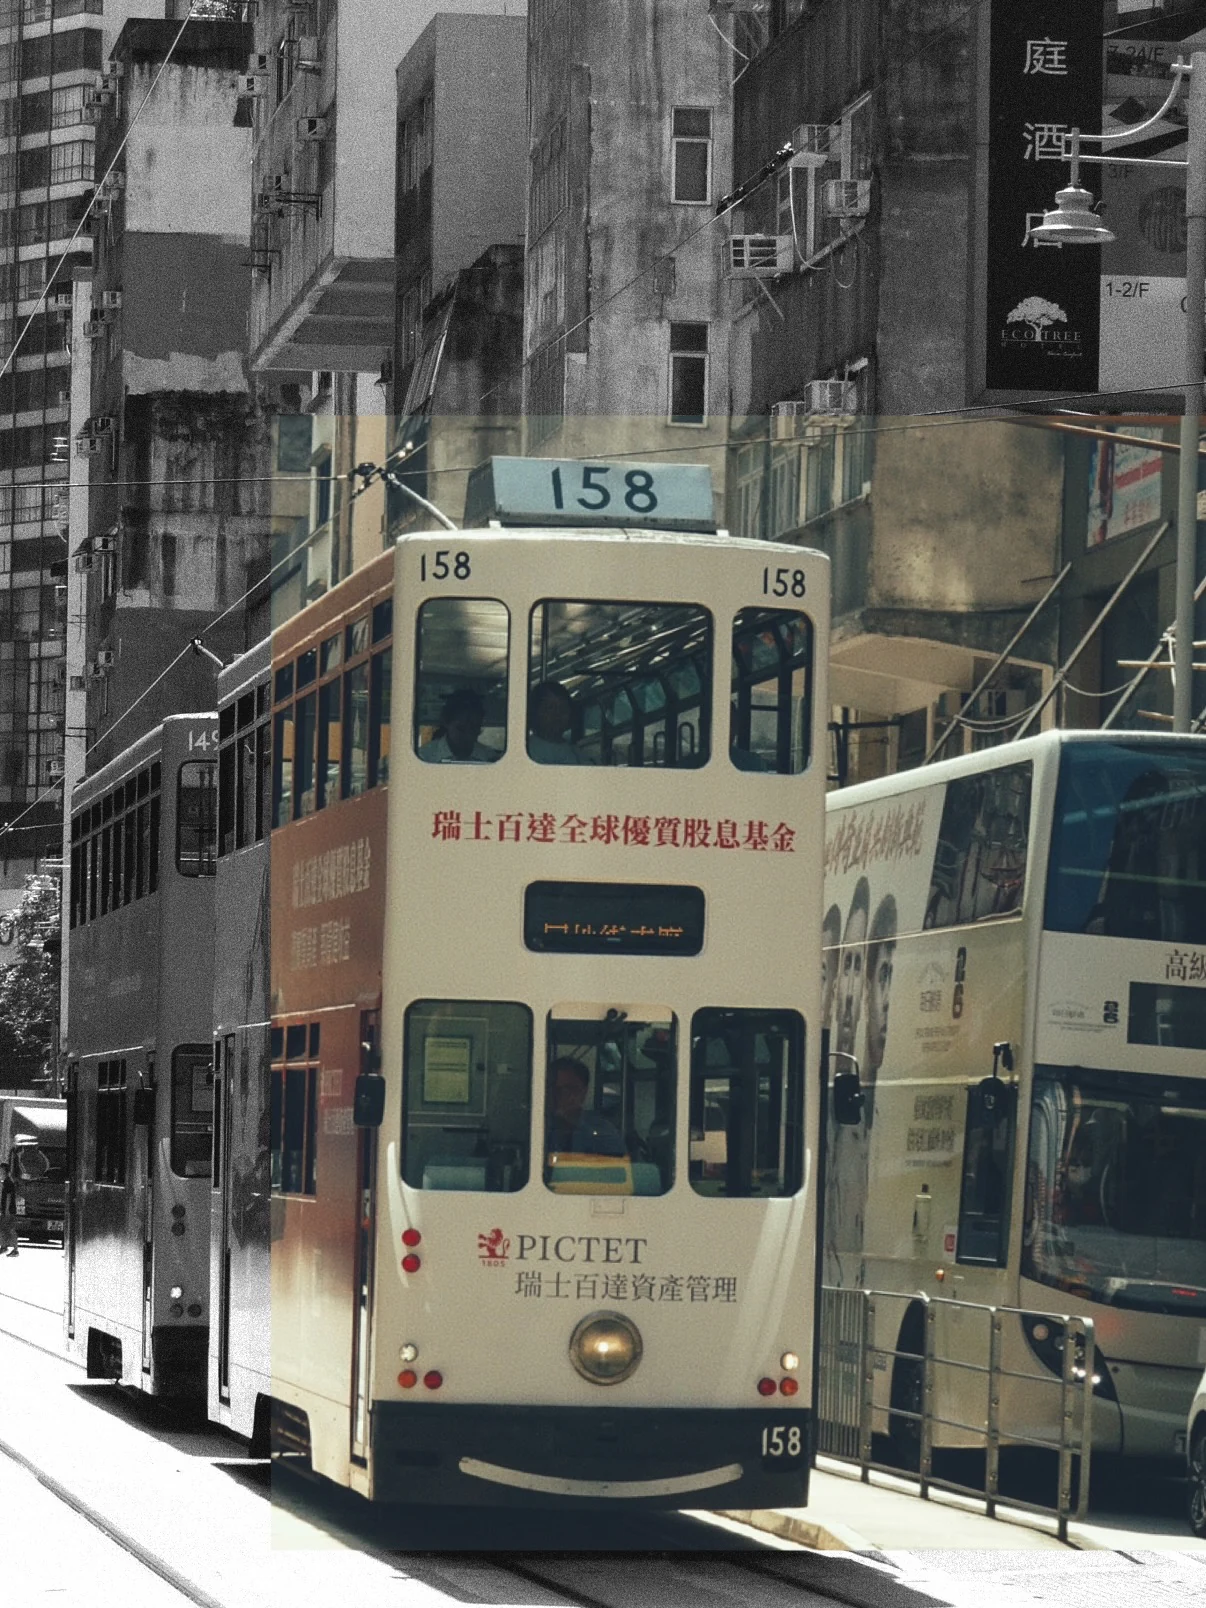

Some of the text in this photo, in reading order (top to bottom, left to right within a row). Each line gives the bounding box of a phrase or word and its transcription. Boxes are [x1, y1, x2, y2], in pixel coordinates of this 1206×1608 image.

[1108, 45, 1164, 64] 724/F
[1105, 282, 1150, 298] 1-2/F
[551, 466, 659, 514] 158
[420, 551, 472, 582] 158
[763, 567, 806, 598] 158
[431, 810, 797, 853] 瑞士百達全球優質股息基金
[481, 1260, 506, 1268] 1805
[515, 1234, 648, 1264] PICTET
[514, 1270, 738, 1303] 瑞士百達資產管理
[762, 1426, 801, 1456] 158
